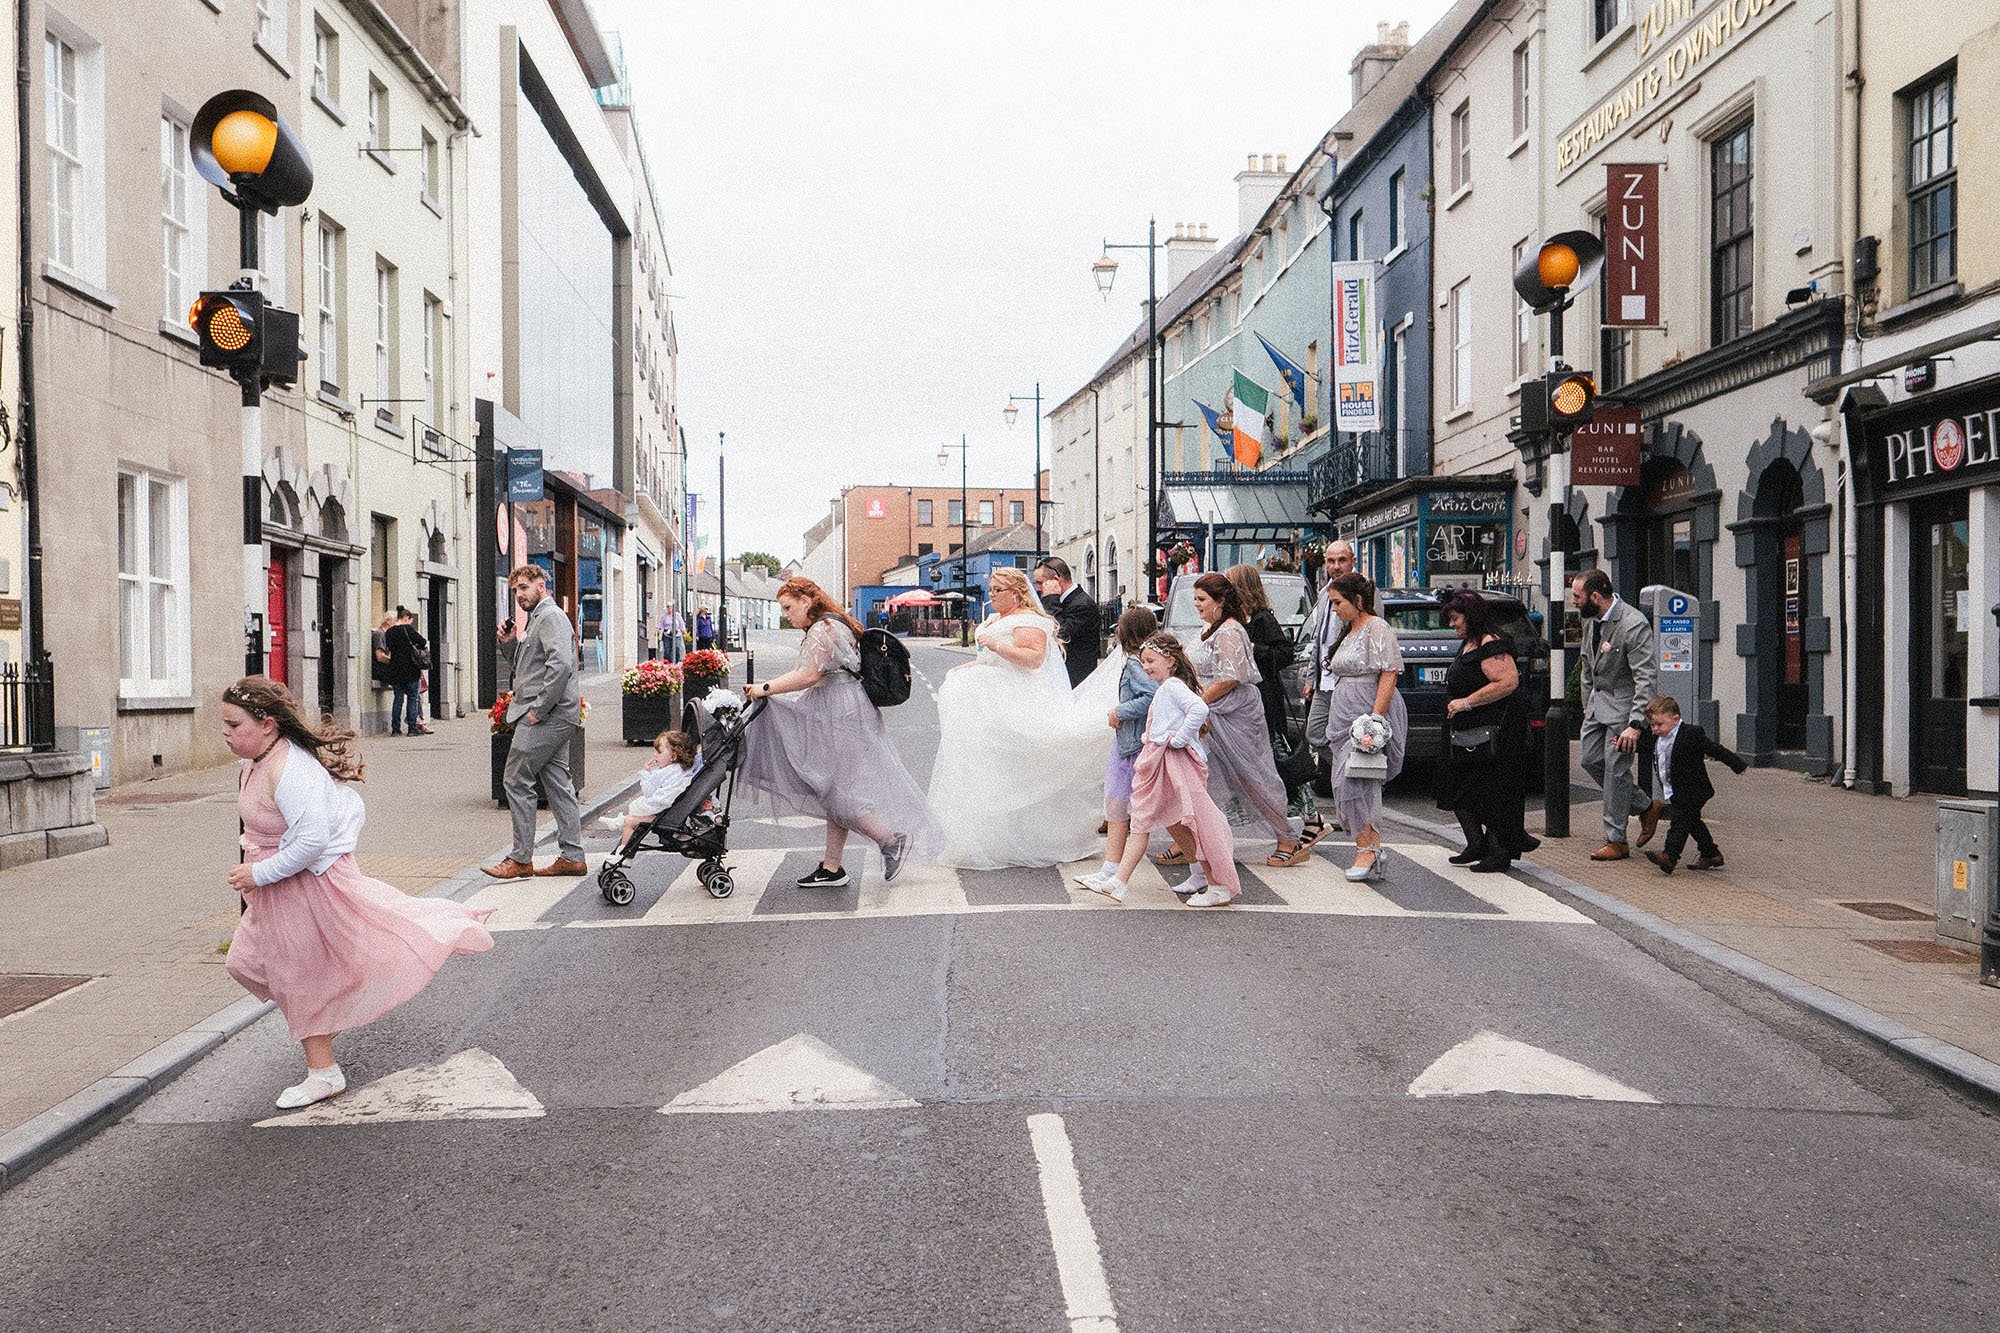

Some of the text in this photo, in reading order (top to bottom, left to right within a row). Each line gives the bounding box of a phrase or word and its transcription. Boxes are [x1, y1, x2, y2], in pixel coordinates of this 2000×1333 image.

[1557, 0, 1774, 172] RESTAURANT & TOWNHOU
[1623, 174, 1644, 290] ZUNI
[1344, 279, 1360, 365] FitzGerald
[1341, 401, 1373, 409] HOUSE
[1341, 408, 1374, 416] FINDERS
[1577, 423, 1621, 434] ZUNI
[1592, 456, 1620, 464] HOTEL
[1662, 474, 1691, 491] ZUNI
[1359, 518, 1367, 530] THE
[1384, 507, 1393, 521] ART
[1392, 503, 1411, 520] GALLERY
[1431, 525, 1481, 545] ART
[1673, 599, 1684, 612] P
